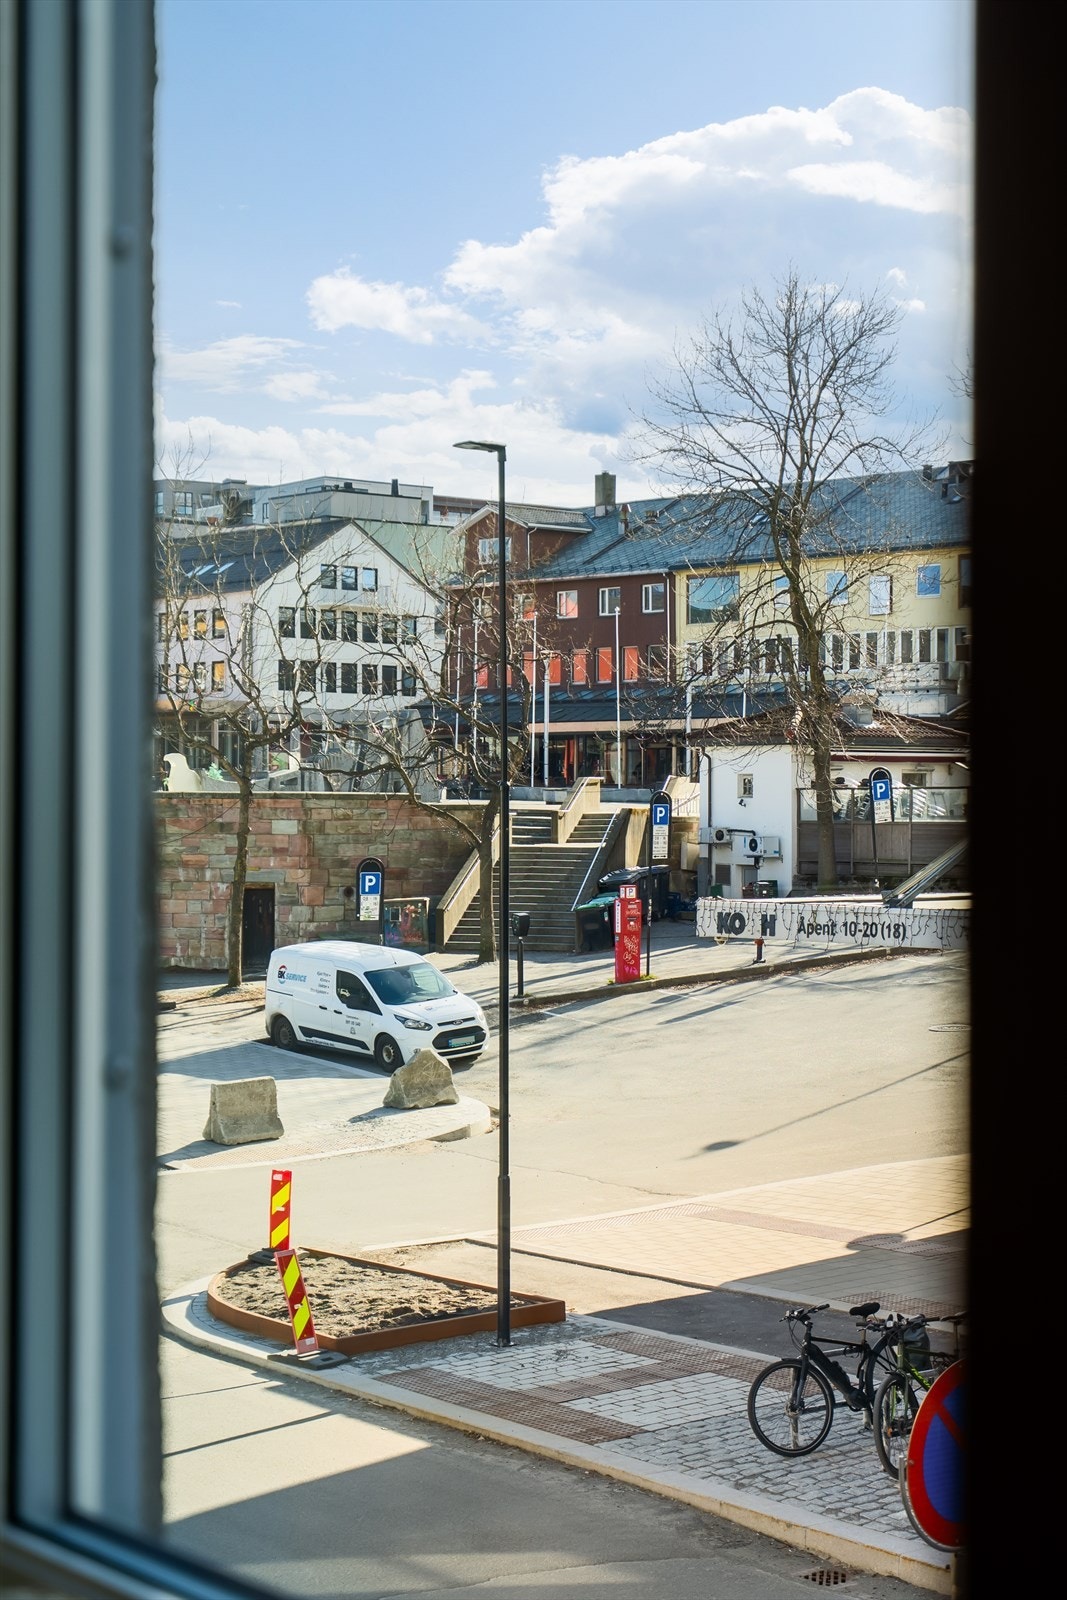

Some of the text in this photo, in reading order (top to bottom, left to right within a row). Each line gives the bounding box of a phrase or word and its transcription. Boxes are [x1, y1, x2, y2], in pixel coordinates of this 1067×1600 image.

[876, 782, 886, 799] P
[656, 806, 666, 823] P
[364, 875, 376, 893] P
[628, 888, 634, 897] P
[798, 916, 835, 938] Åpent
[285, 972, 307, 982] SERVICE
